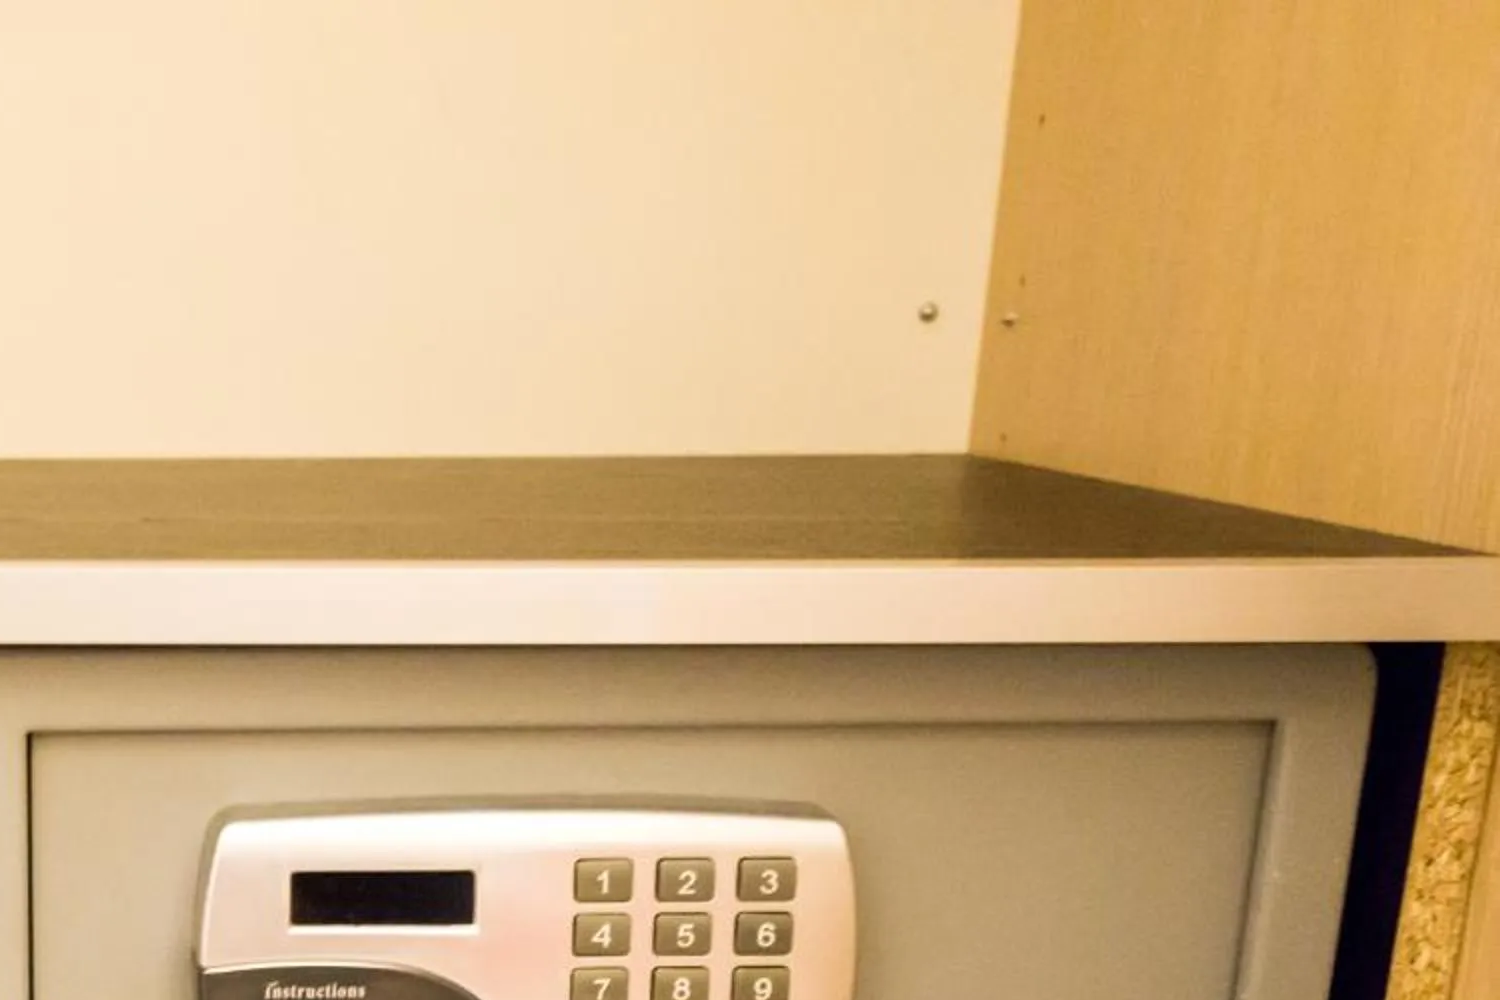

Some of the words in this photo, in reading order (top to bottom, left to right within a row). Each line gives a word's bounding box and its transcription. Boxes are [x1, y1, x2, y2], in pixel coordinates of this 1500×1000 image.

[597, 870, 609, 894] 1
[678, 870, 697, 895] 2
[760, 870, 779, 894] 3
[591, 924, 612, 948] 4
[677, 924, 695, 947] 5
[757, 923, 776, 947] 6
[264, 980, 366, 999] Instructions
[754, 978, 772, 1000] 9
